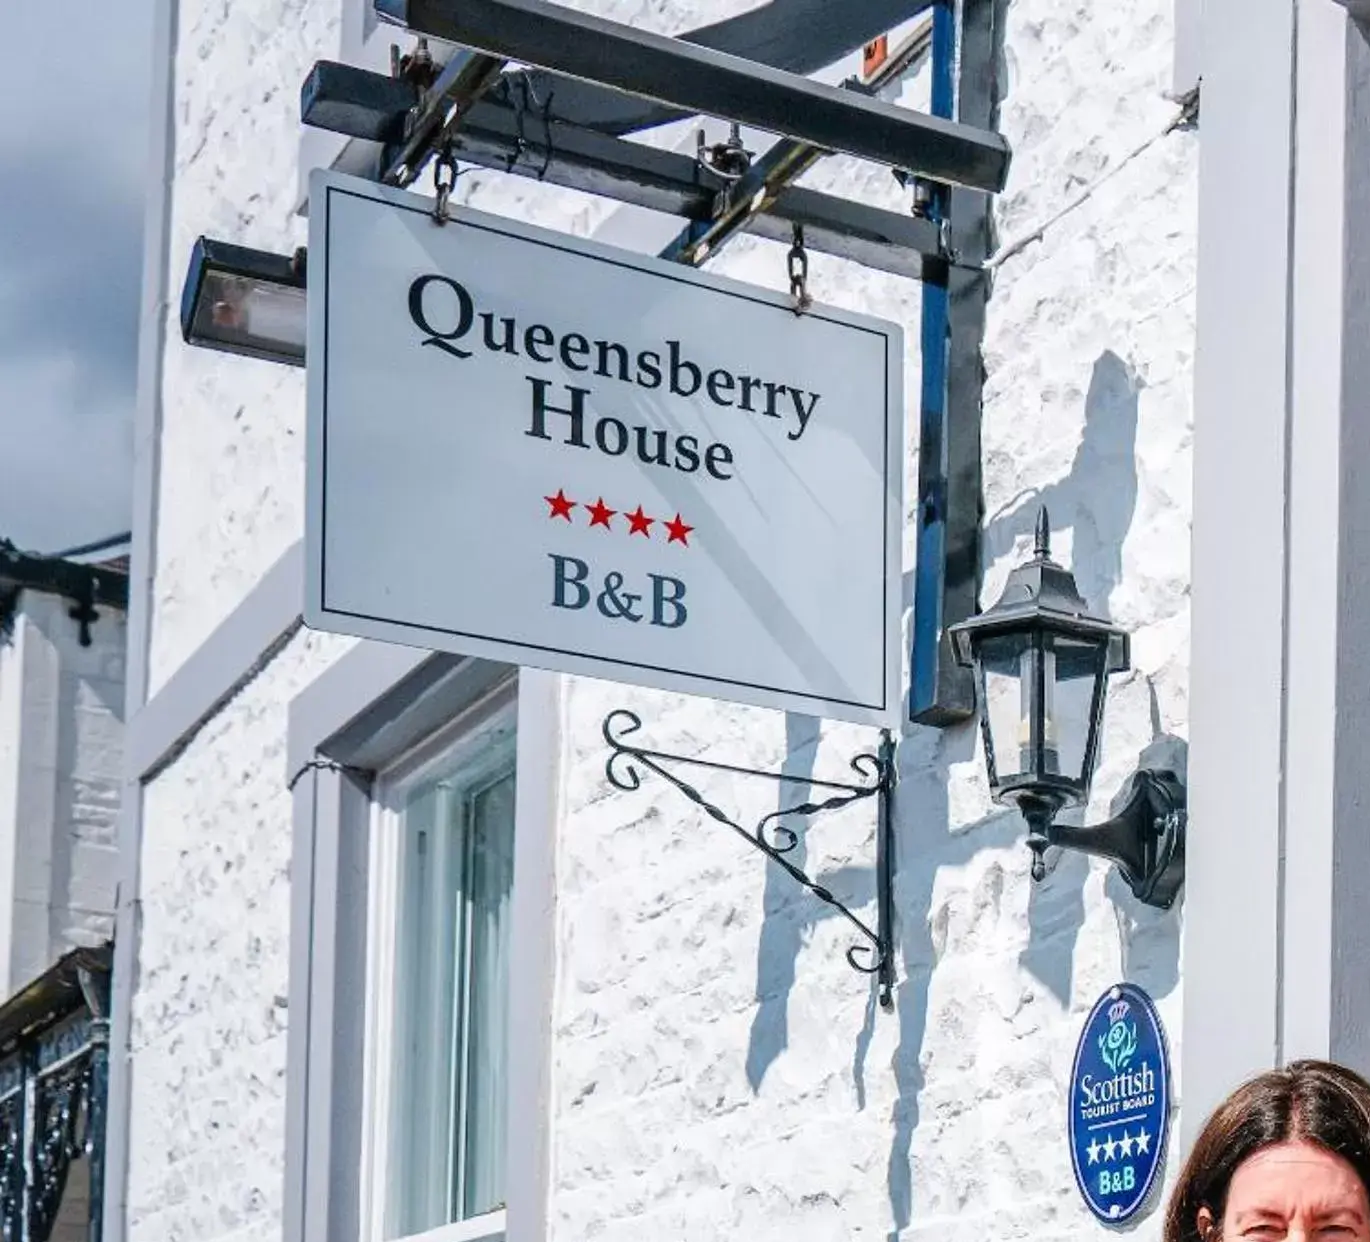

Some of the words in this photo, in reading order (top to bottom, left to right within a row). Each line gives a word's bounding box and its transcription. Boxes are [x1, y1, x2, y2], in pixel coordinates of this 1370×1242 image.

[407, 273, 820, 441] Queensberry
[523, 376, 734, 481] House
[547, 553, 688, 630] B&B
[1081, 1062, 1154, 1106] Scottish
[1081, 1101, 1120, 1120] TOURIST
[1123, 1094, 1155, 1111] BOARD
[1099, 1166, 1135, 1195] B&B
